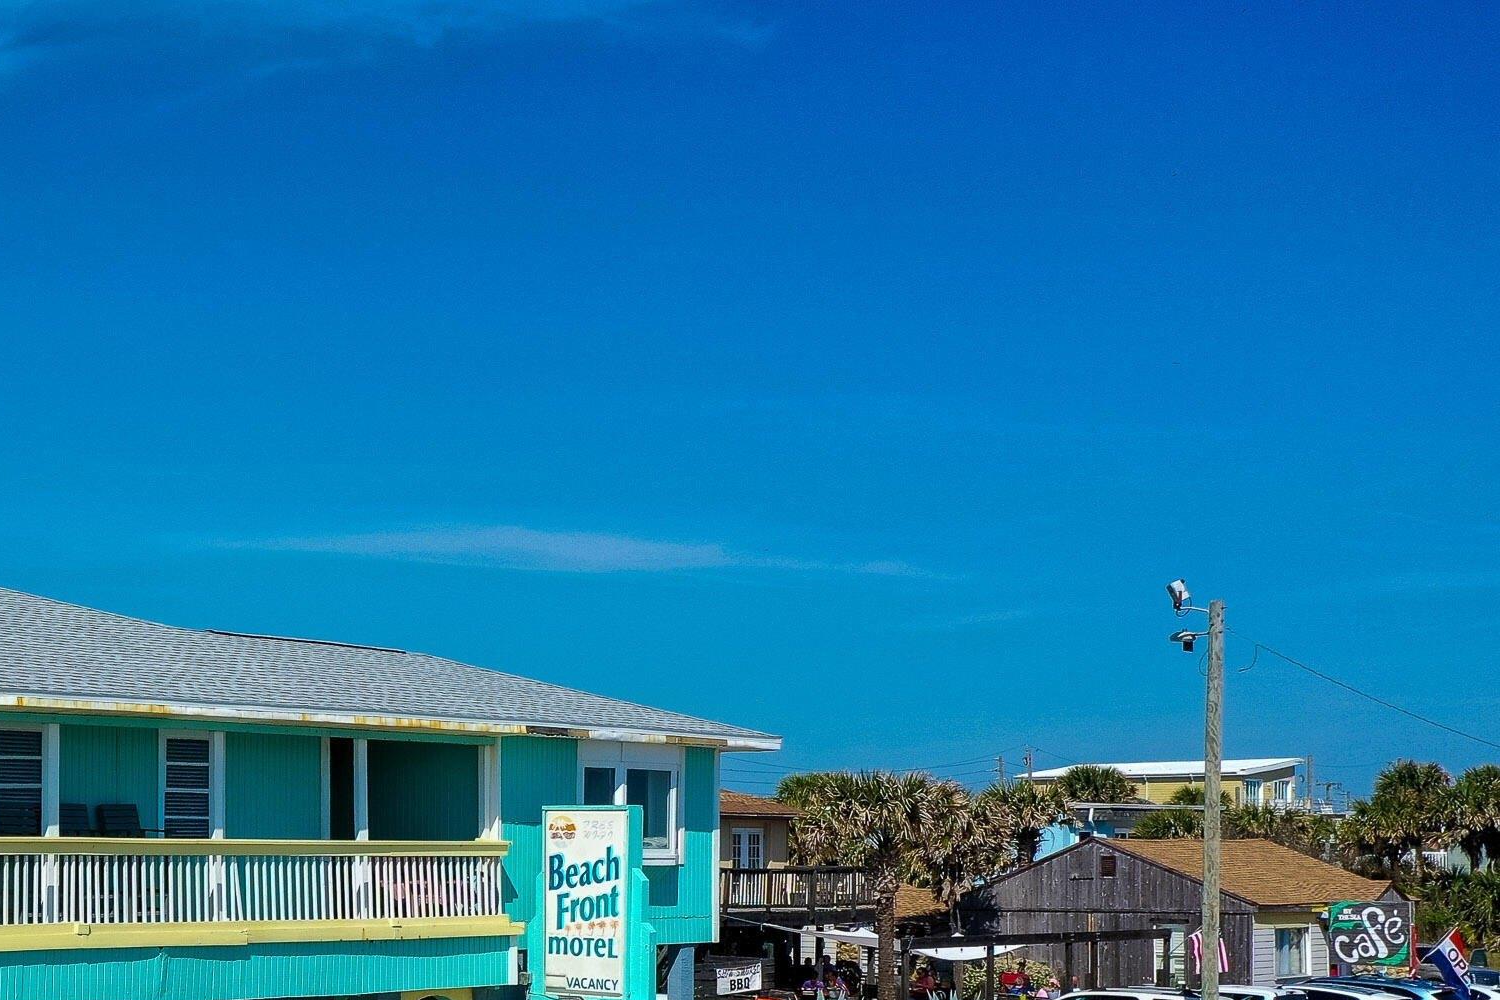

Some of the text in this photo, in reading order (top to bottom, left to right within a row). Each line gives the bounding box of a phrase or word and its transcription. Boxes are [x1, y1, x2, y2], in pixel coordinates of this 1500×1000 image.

[548, 845, 620, 891] Beach
[556, 885, 620, 930] Front
[566, 977, 619, 991] VACANCY
[730, 977, 750, 991] BBQ
